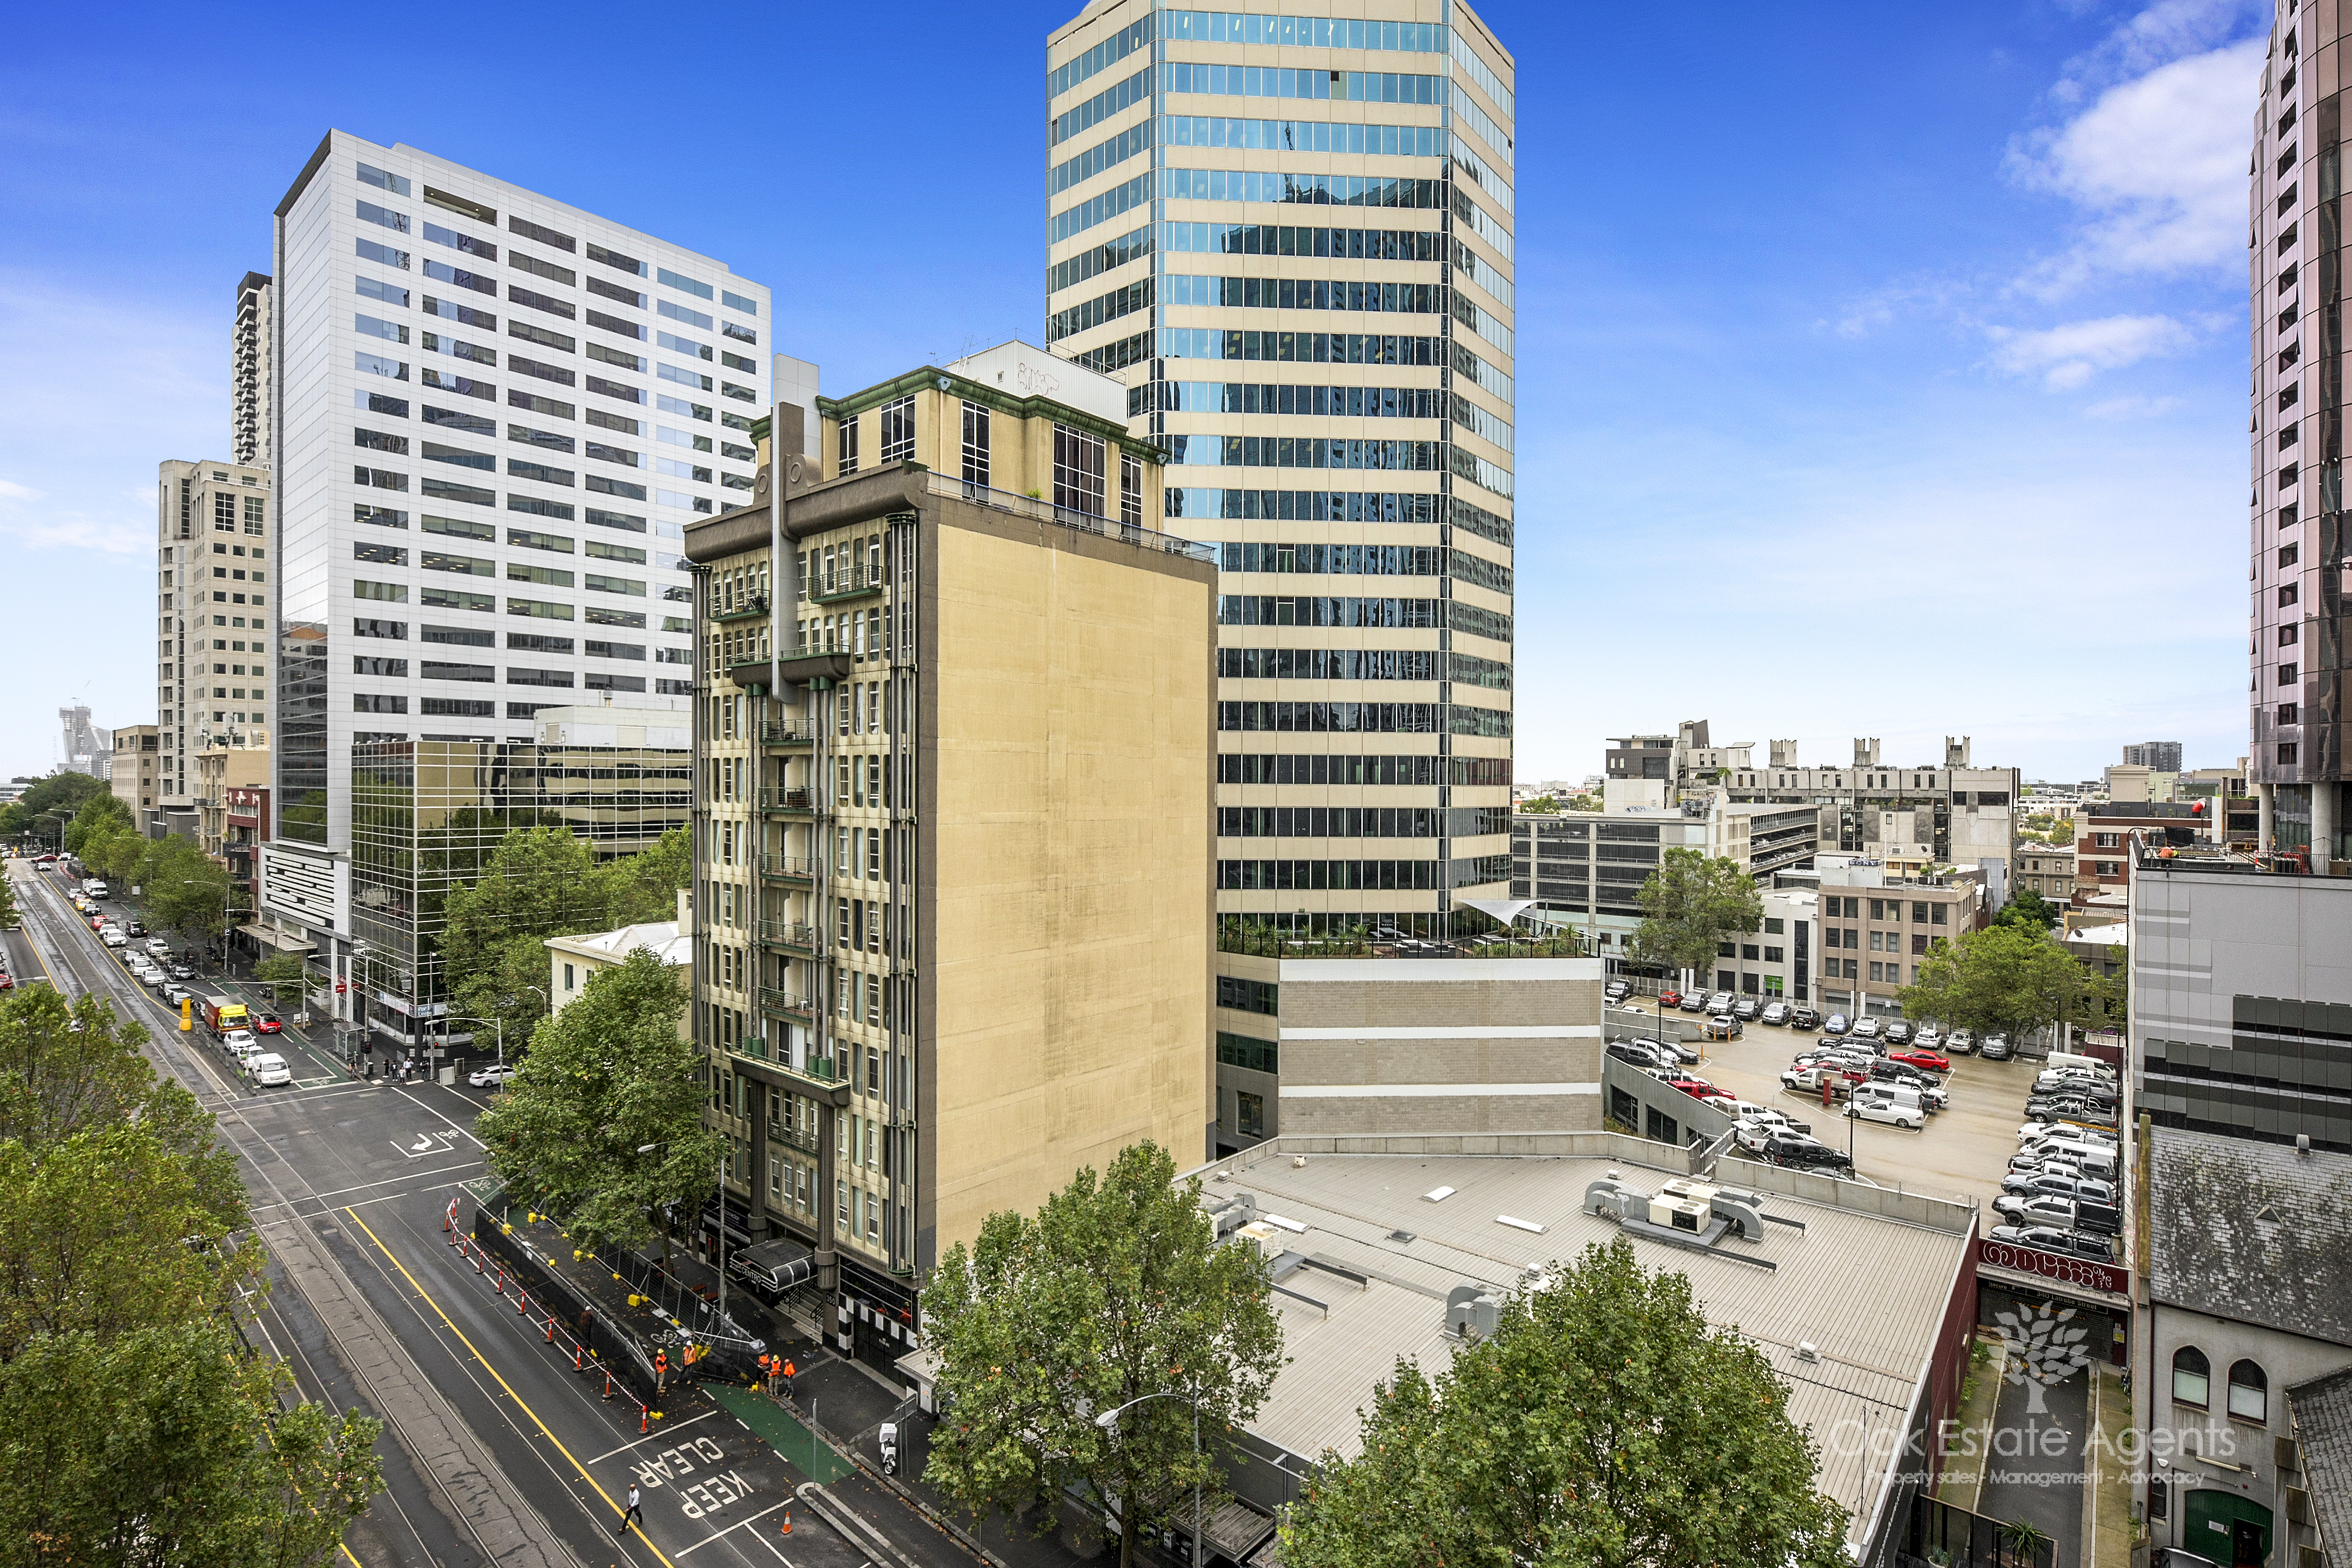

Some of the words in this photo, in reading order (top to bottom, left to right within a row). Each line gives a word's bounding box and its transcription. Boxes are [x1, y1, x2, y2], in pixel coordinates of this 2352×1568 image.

[741, 1266, 761, 1283] CENTRO
[2052, 1294, 2075, 1305] Latrobe
[2077, 1300, 2097, 1310] Street
[629, 1437, 724, 1488] CLEAR
[682, 1470, 754, 1519] KEEP
